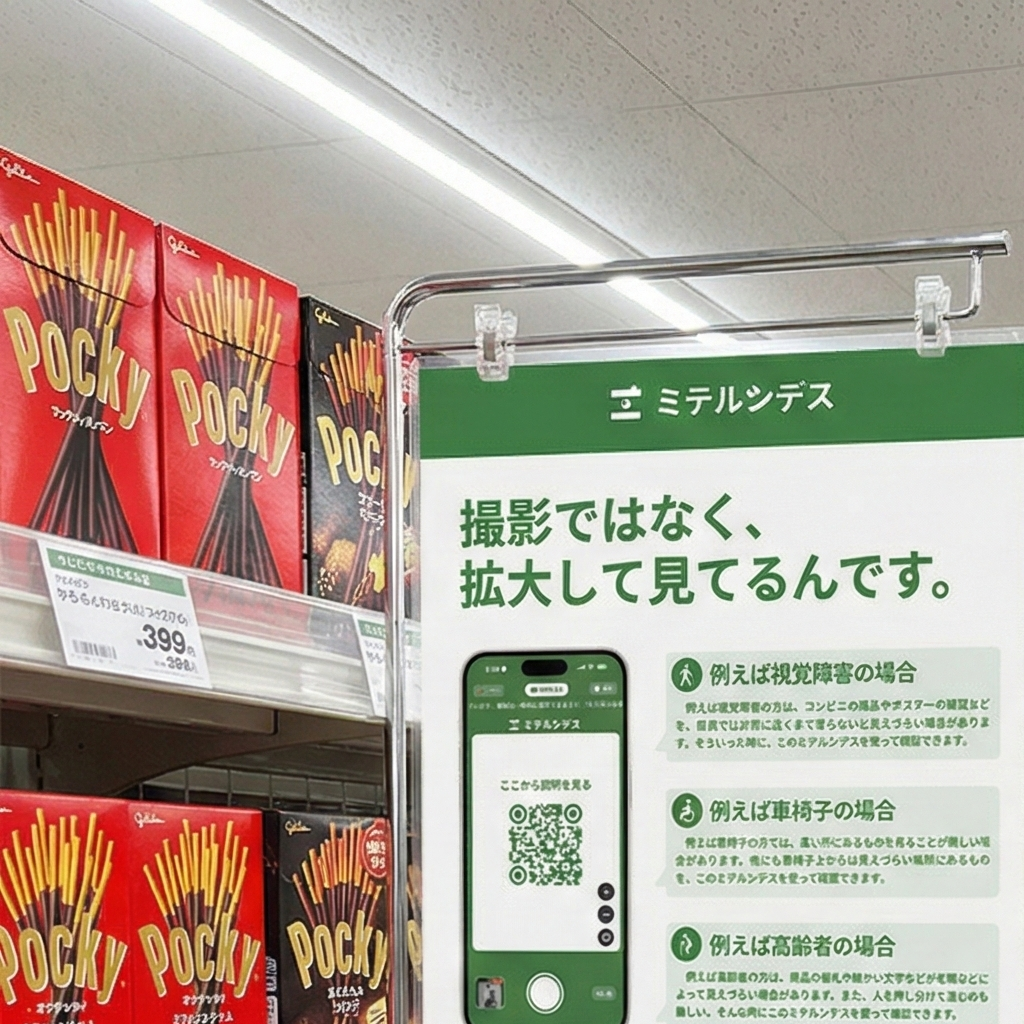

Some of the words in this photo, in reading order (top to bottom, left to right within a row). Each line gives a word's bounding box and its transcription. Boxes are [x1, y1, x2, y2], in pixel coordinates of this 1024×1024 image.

[459, 493, 763, 548] 撮影ではなく、
[459, 550, 952, 609] 拡大して見てるんです。
